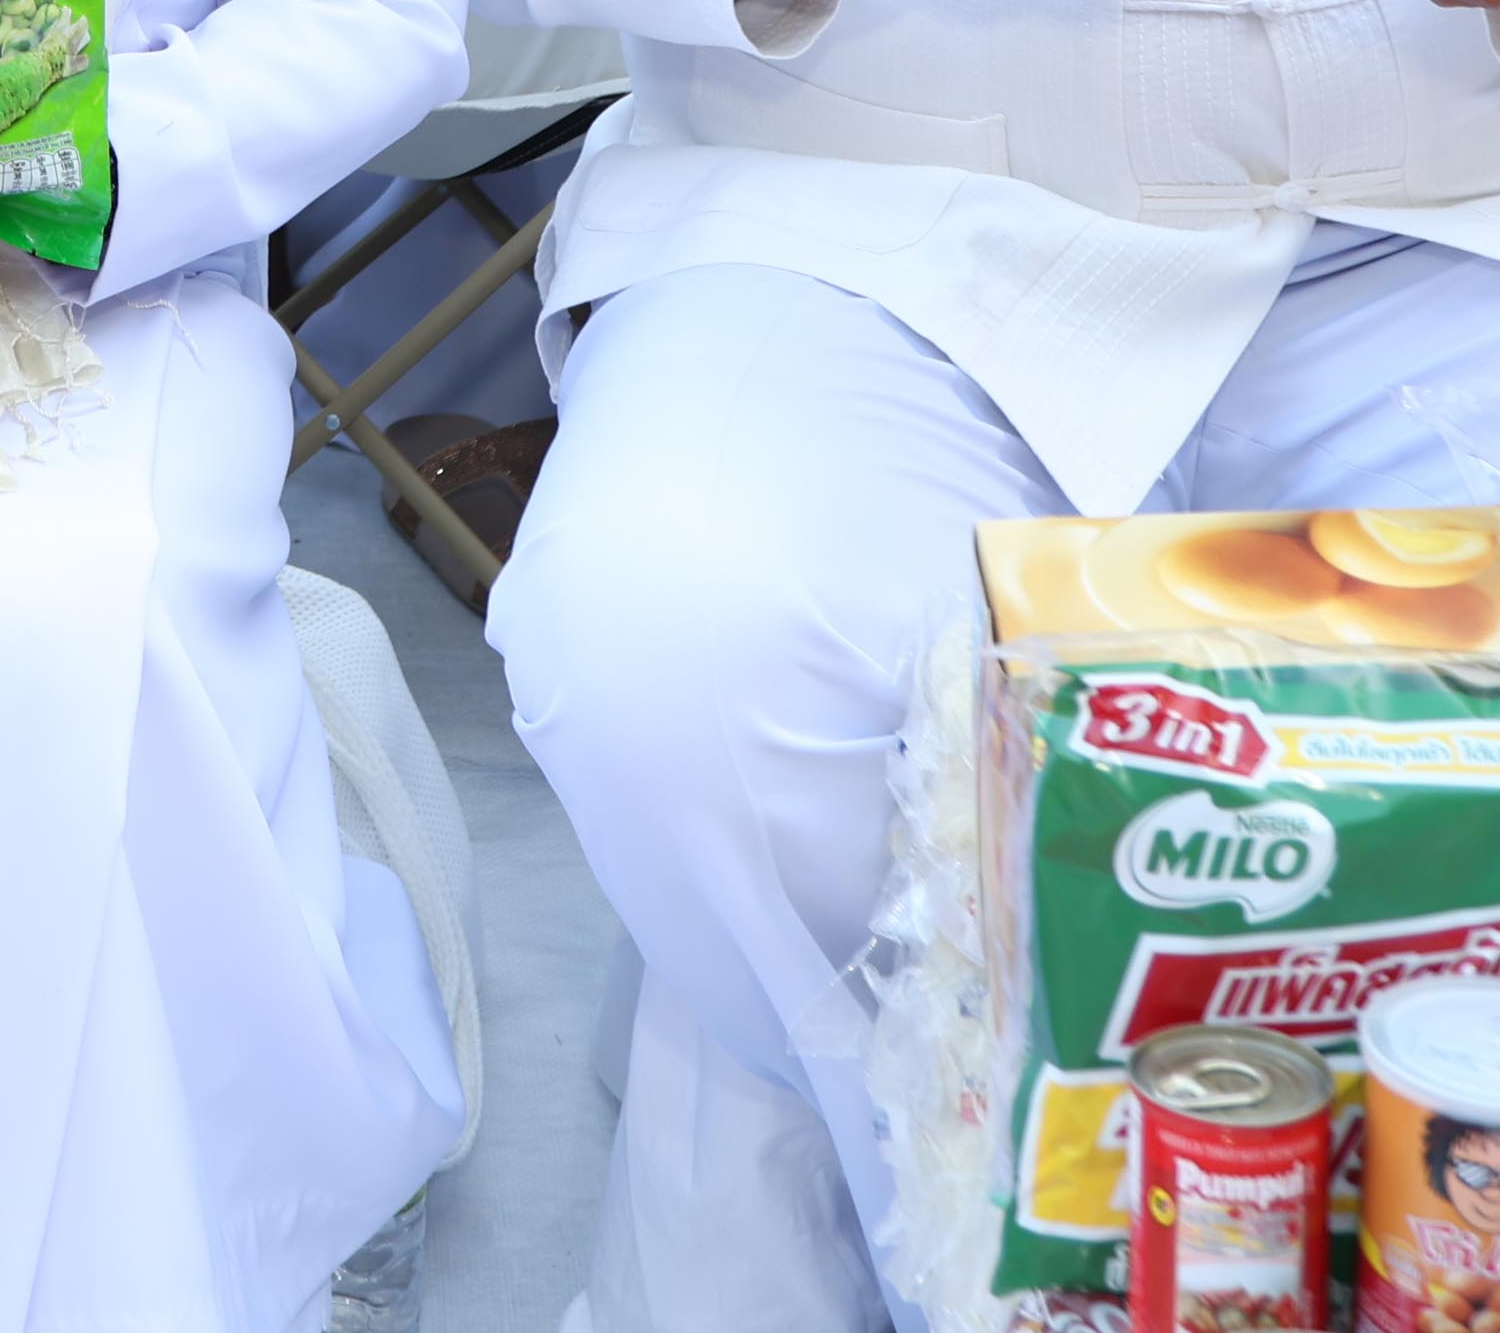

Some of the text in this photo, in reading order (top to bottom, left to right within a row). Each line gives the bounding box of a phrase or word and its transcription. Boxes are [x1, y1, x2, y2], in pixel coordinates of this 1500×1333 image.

[1102, 693, 1245, 767] 3 in 1
[1147, 829, 1313, 882] MILO
